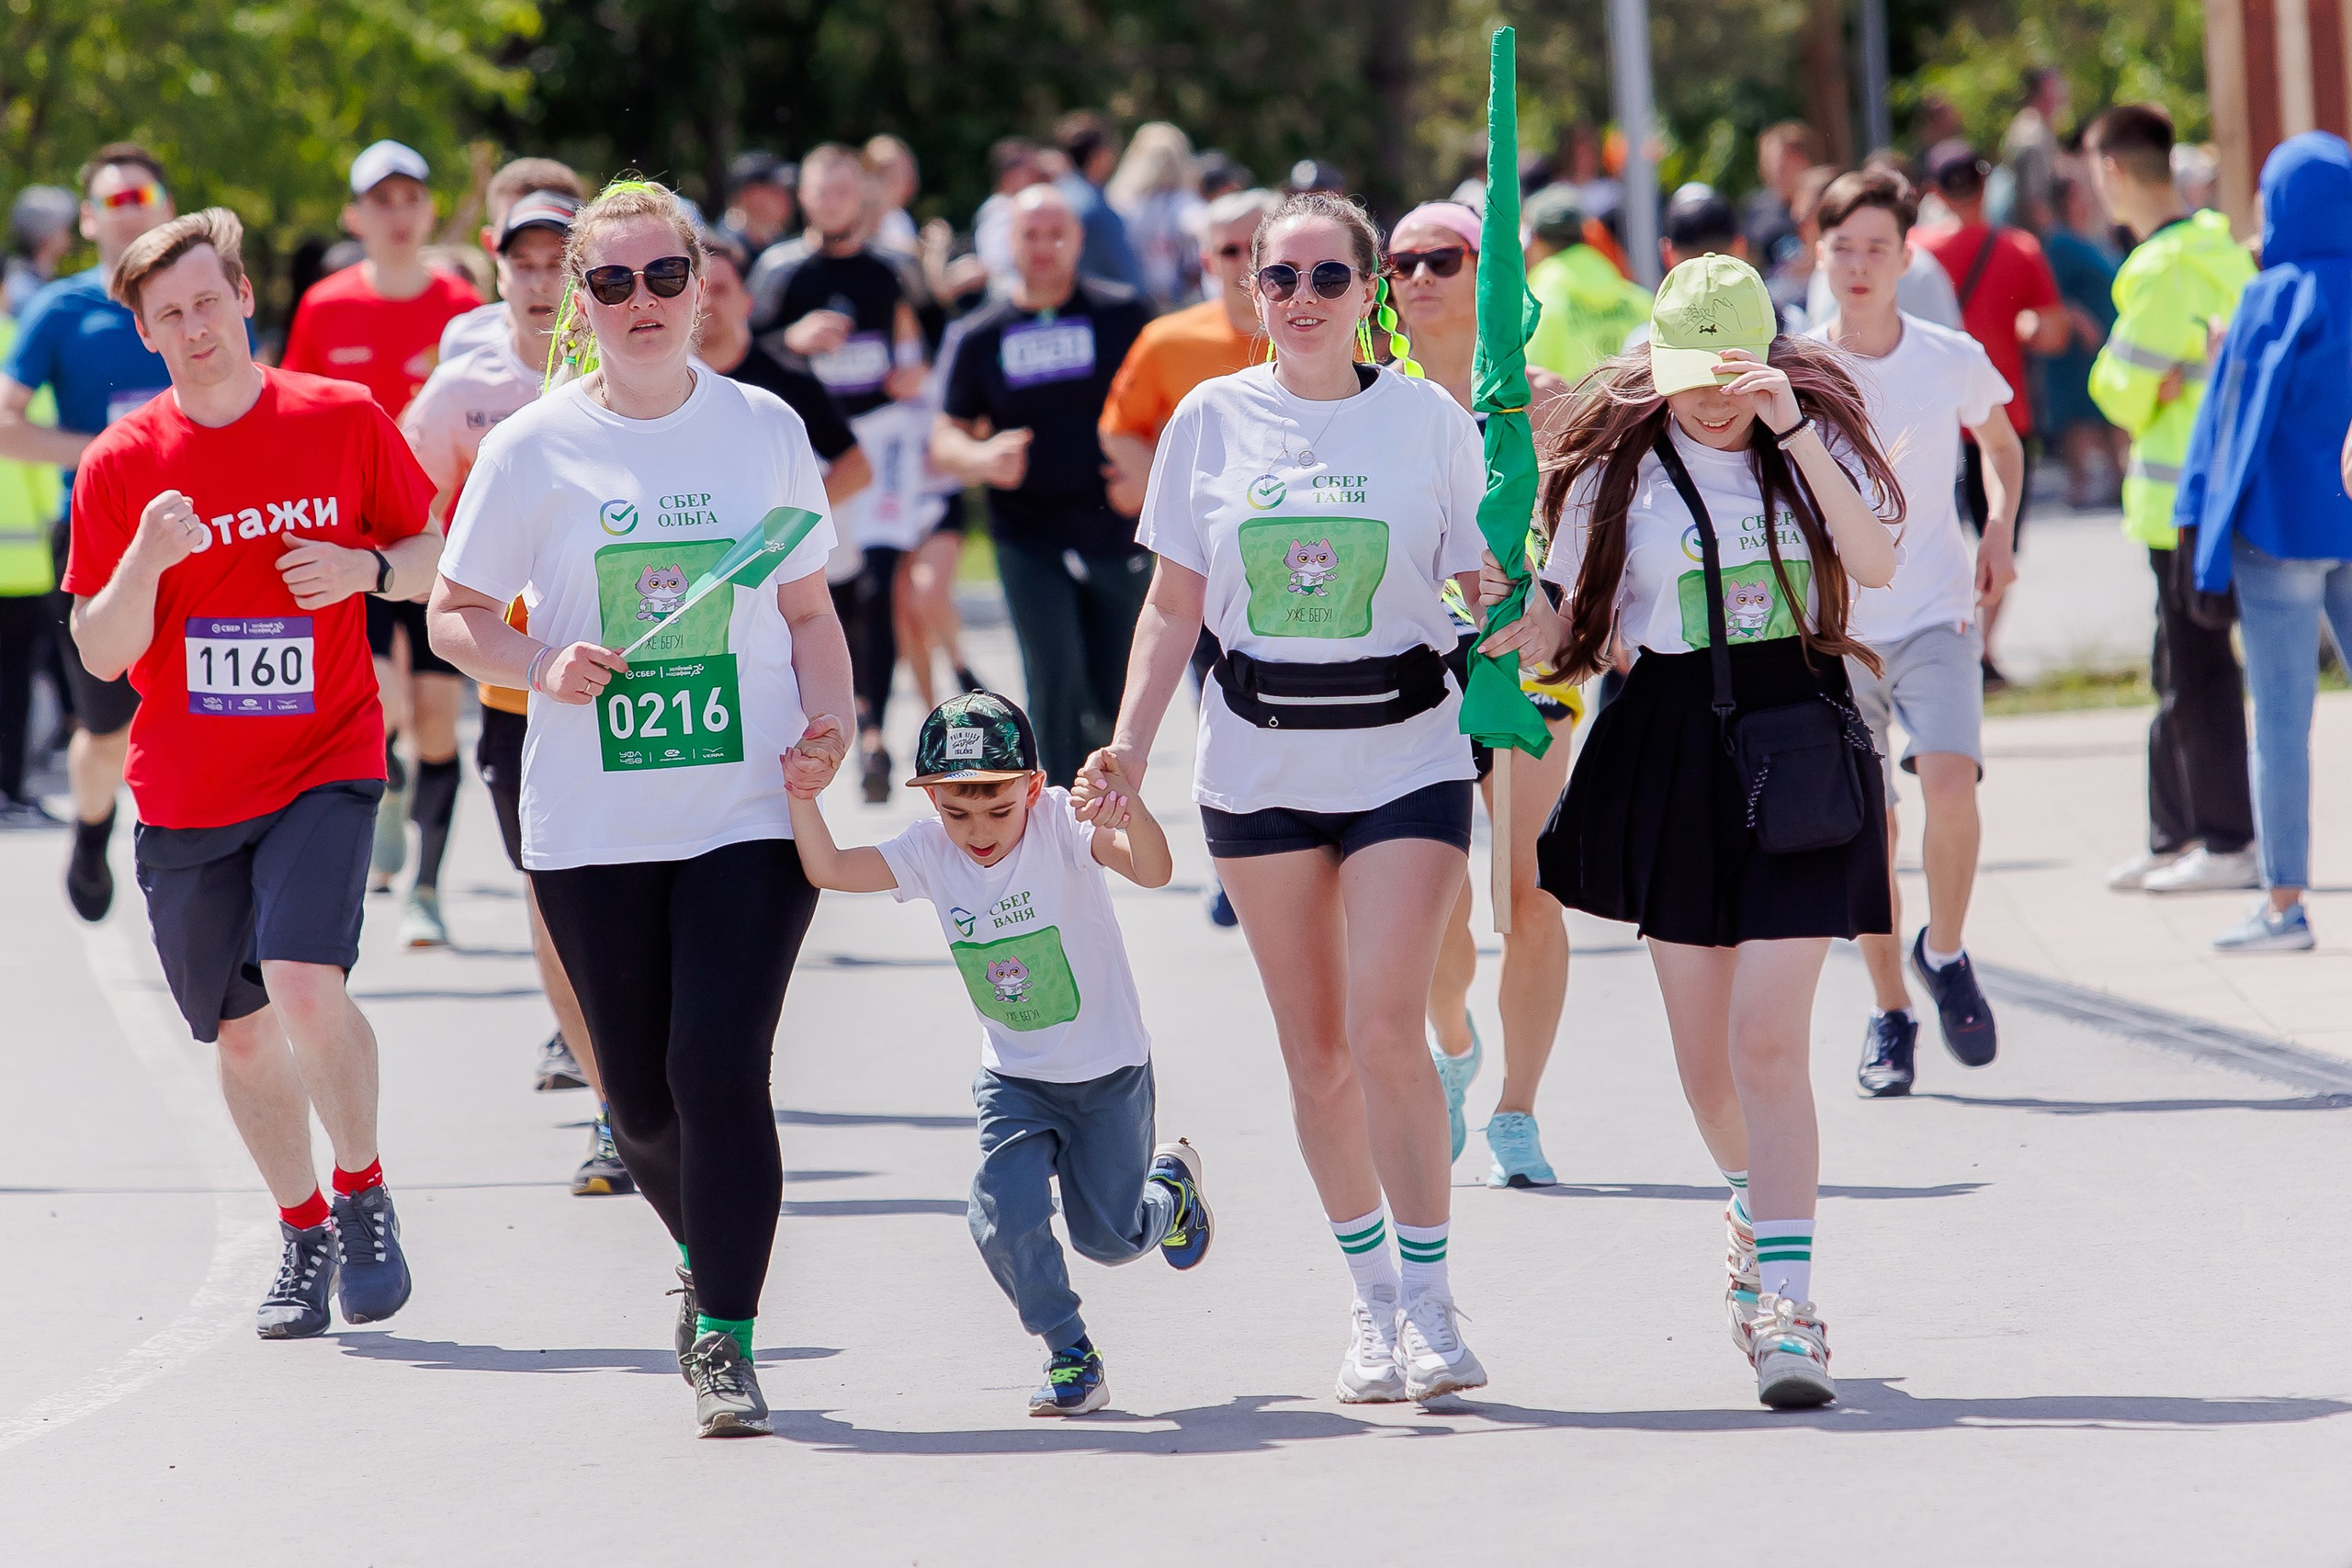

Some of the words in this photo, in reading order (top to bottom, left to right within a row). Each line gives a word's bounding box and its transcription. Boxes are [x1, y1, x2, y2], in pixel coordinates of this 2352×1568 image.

[1312, 475, 1369, 489] СБЕР
[659, 492, 712, 510] СБЕР
[1312, 491, 1367, 503] ТАНЯ
[658, 510, 718, 528] ОЛЬГА
[1285, 607, 1306, 623] УЖЕ
[1308, 607, 1333, 623] БЕГУ!
[660, 634, 684, 649] БЕГУ!
[199, 645, 303, 688] 1160
[635, 670, 657, 678] СБЕР
[607, 686, 729, 739] 0216
[989, 890, 1032, 916] СБЕР
[992, 907, 1036, 930] ВАНЯ
